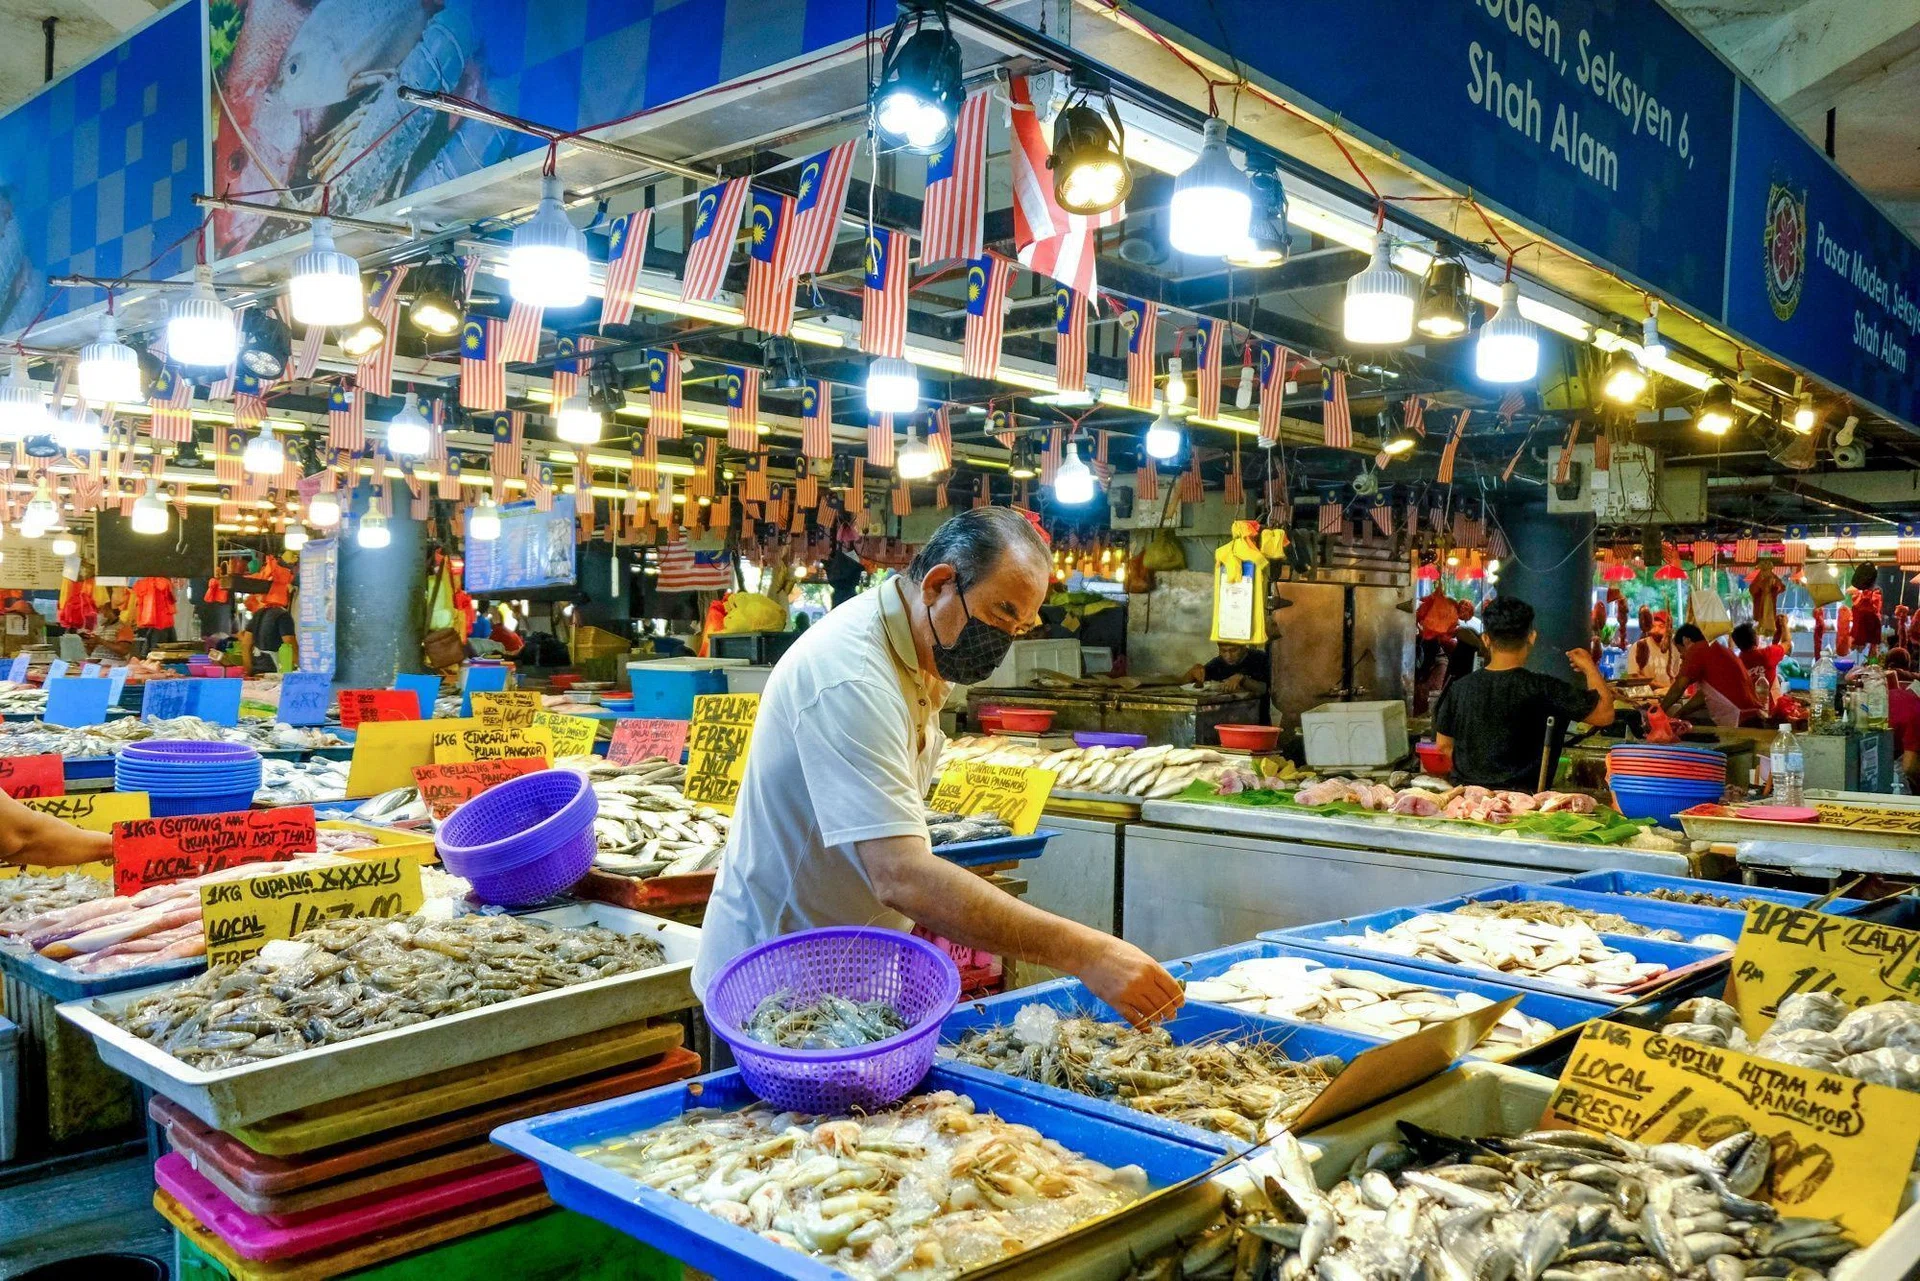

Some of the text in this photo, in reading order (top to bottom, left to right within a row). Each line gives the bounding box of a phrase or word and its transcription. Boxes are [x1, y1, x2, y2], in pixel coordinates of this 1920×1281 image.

[1467, 41, 1617, 191] Shah Alam
[1576, 29, 1672, 147] Seksyen
[1678, 112, 1694, 169] 6,
[1816, 221, 1850, 278] Pasar
[1851, 250, 1890, 313] Moden,
[1853, 309, 1906, 373] Shah Alam
[435, 733, 457, 746] 1KG
[474, 746, 501, 757] PULAU
[122, 821, 156, 838] 1KG
[252, 831, 277, 847] NOT
[143, 857, 196, 878] LOCAL
[205, 886, 243, 905] 1KG
[209, 915, 266, 940] LOCAL
[1747, 903, 1841, 952] 1PEK
[1571, 1053, 1654, 1093] LOCAL
[1582, 1021, 1632, 1049] 1KG
[1738, 1061, 1807, 1097] HITAM
[1552, 1087, 1641, 1131] FRESH
